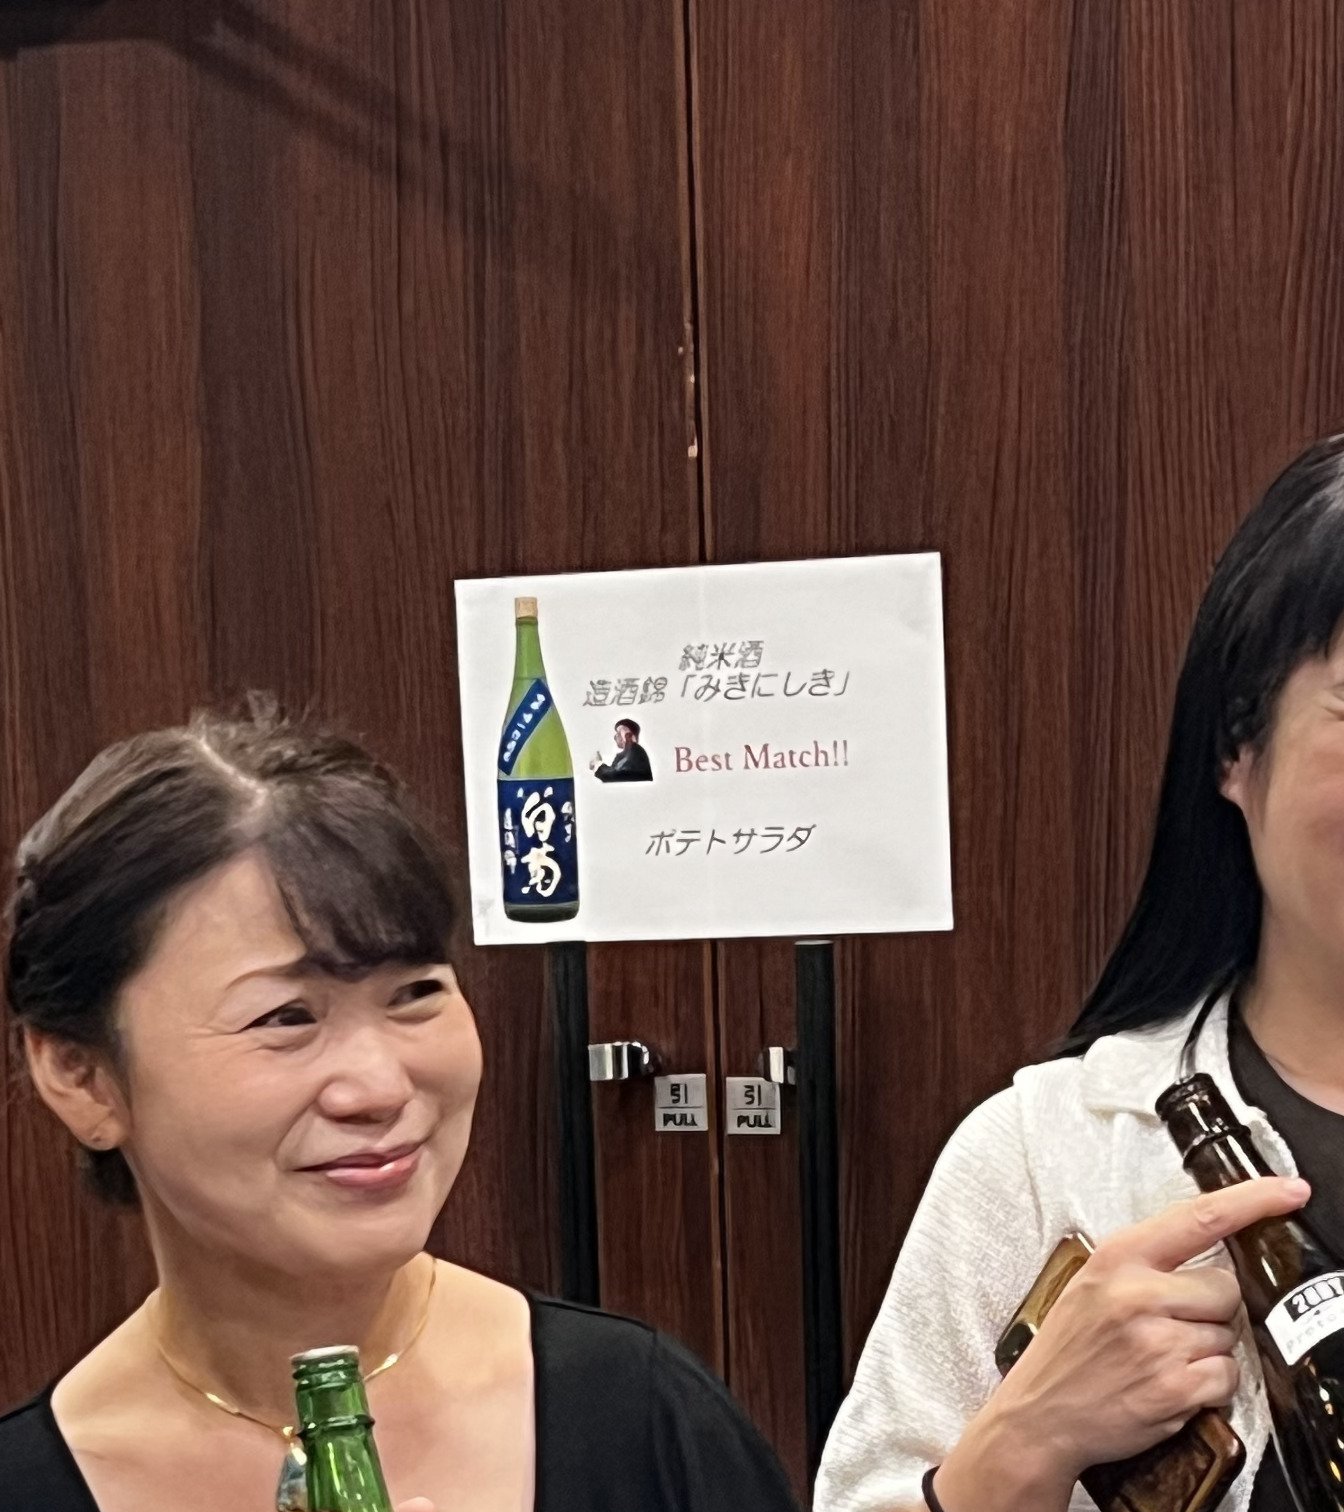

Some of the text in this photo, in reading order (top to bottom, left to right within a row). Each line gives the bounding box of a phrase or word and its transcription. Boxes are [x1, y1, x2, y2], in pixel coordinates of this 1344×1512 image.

[678, 639, 764, 671] 純米酒
[674, 739, 850, 774] Best Match!!
[645, 823, 818, 858] ポテトサラダ
[662, 1112, 699, 1127] PULL
[736, 1113, 773, 1129] PULL
